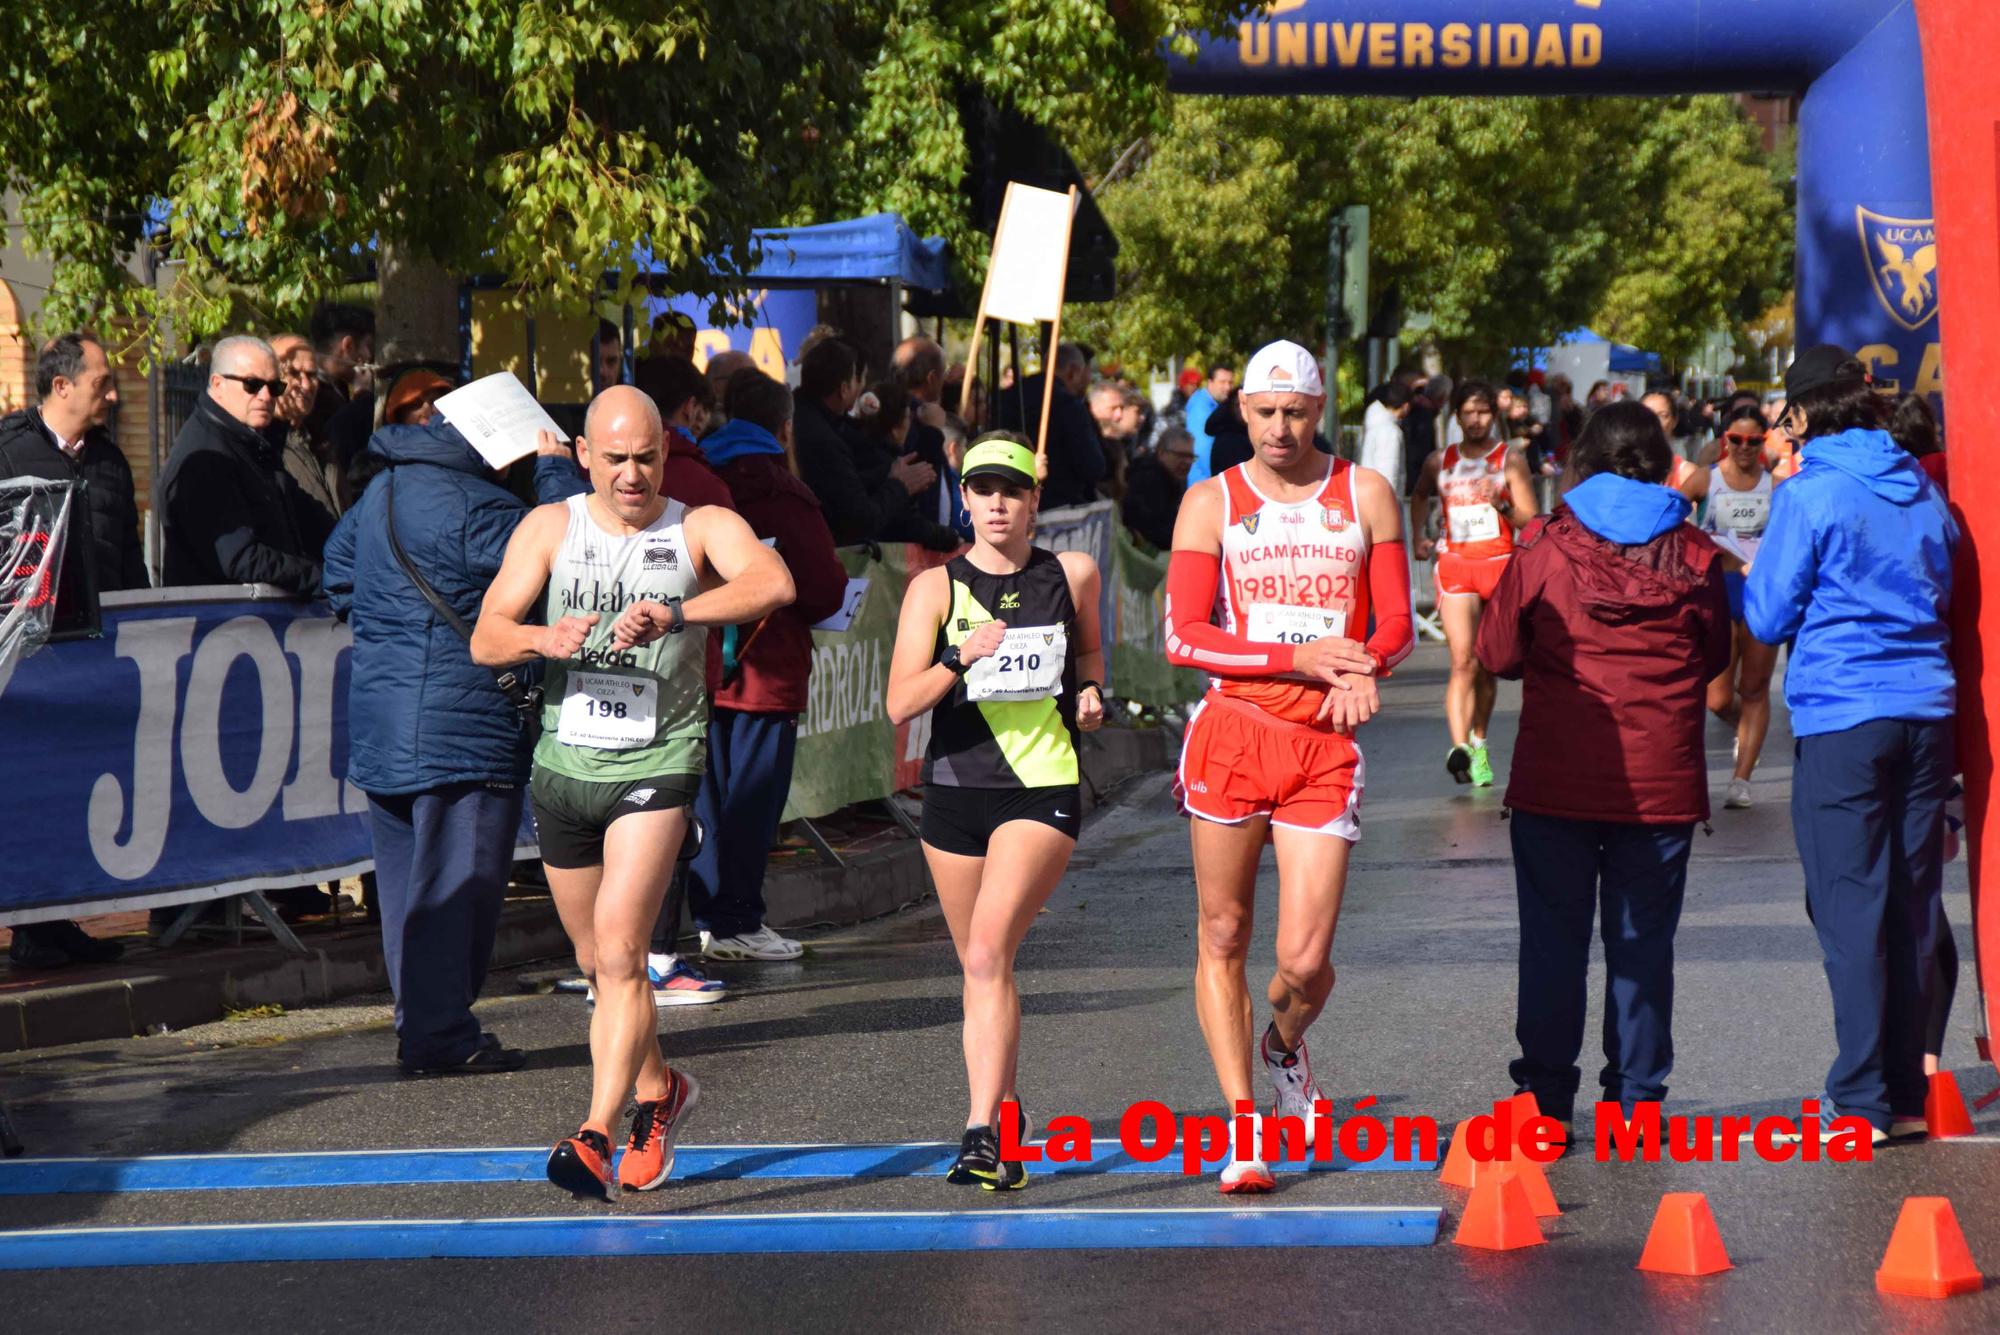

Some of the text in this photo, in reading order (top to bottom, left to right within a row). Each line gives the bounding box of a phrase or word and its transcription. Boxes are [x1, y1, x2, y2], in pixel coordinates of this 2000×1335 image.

[1239, 21, 1602, 68] UNIVERSIDAD
[1732, 508, 1756, 519] 205
[1236, 574, 1357, 601] 1981-2021
[1017, 632, 1041, 640] ATHLEO
[999, 653, 1041, 672] 210
[585, 678, 630, 688] UCAM ATHLEO
[597, 688, 616, 696] CIEZA
[797, 638, 883, 738] RDROLA
[586, 699, 627, 719] 198
